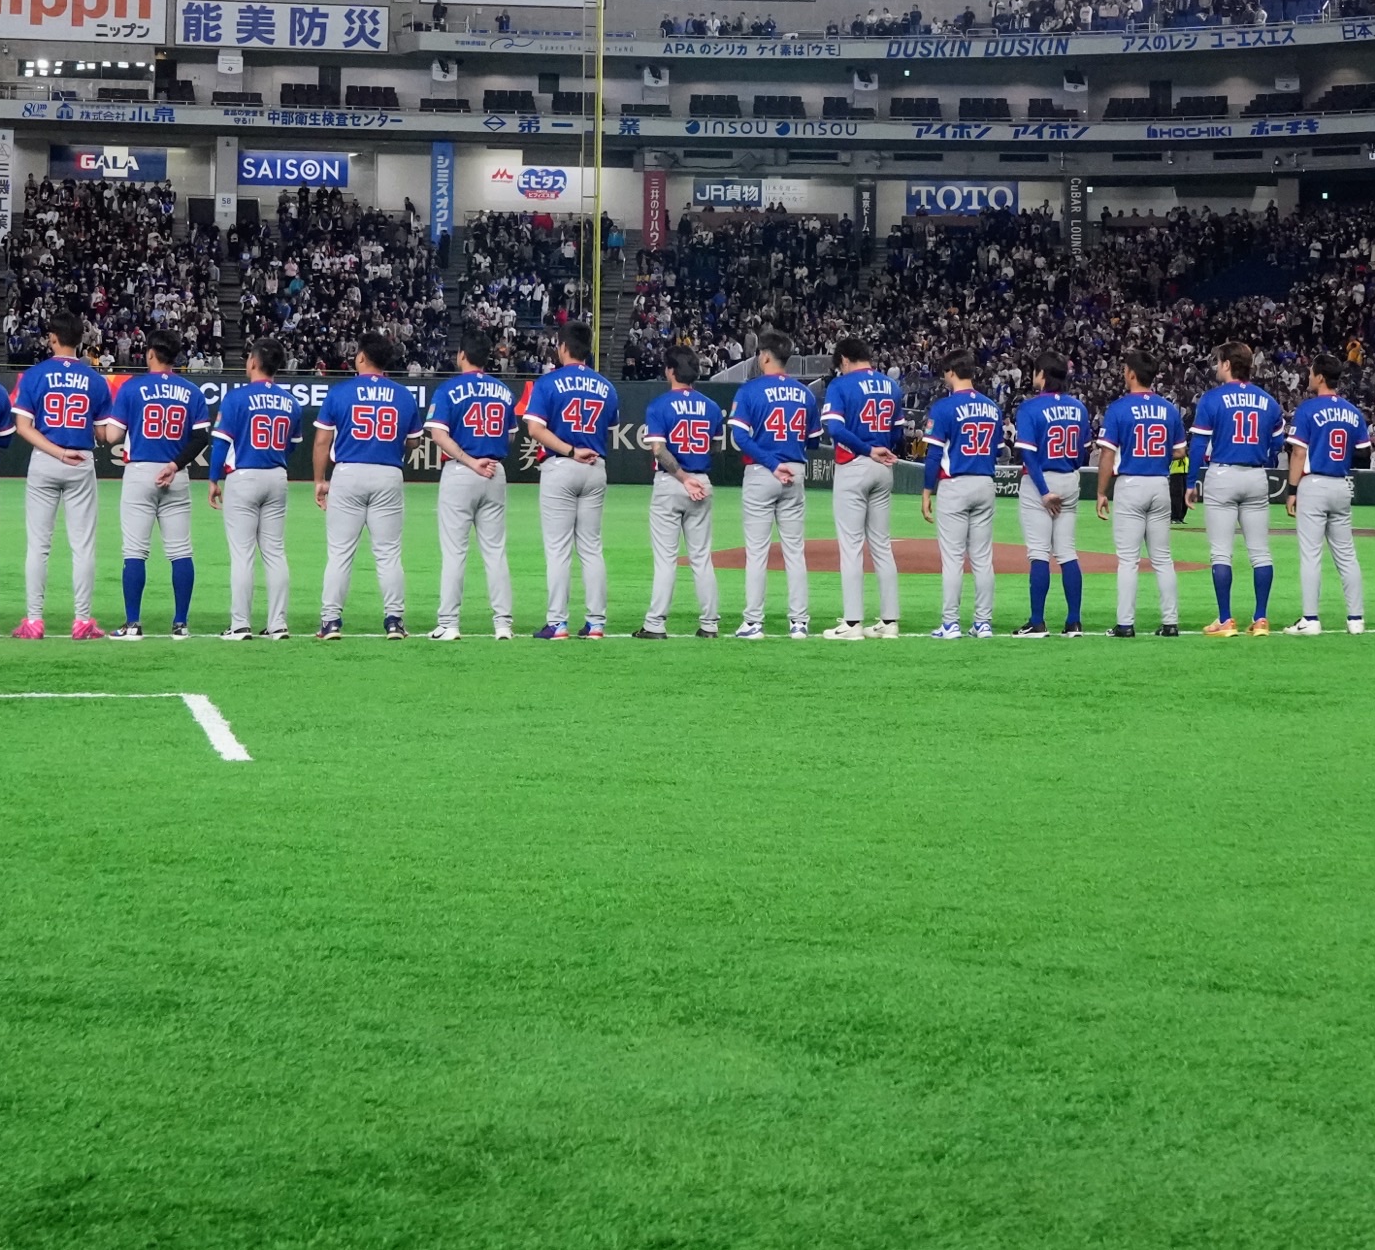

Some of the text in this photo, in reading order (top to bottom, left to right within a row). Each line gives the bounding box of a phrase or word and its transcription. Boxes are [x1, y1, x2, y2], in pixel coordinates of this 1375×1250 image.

[95, 23, 149, 38] ニップン
[182, 2, 381, 48] 能美防災
[663, 44, 695, 55] APA
[518, 116, 640, 135] 第一業
[912, 123, 1090, 139] アイホン アイホン
[1159, 126, 1232, 138] HOCHIKI
[81, 154, 140, 171] GALA
[242, 158, 340, 180] SAISON
[696, 185, 758, 201] JR貨物
[911, 186, 1013, 210] TOTO
[1070, 177, 1081, 213] CuBAR
[357, 387, 394, 402] C.W.HU
[554, 377, 609, 399] H.C.CHENG
[43, 392, 89, 429] 92
[142, 403, 187, 440] 88
[351, 404, 398, 442] 58
[462, 402, 505, 438] 48
[561, 397, 605, 434] 47
[764, 407, 807, 442] 44
[859, 398, 895, 433] 42
[1232, 410, 1260, 445] 11
[250, 414, 291, 451] 60
[669, 419, 710, 454] 45
[961, 421, 996, 456] 37
[1047, 425, 1080, 459] 20
[1132, 423, 1167, 458] 12
[1329, 428, 1347, 462] 9
